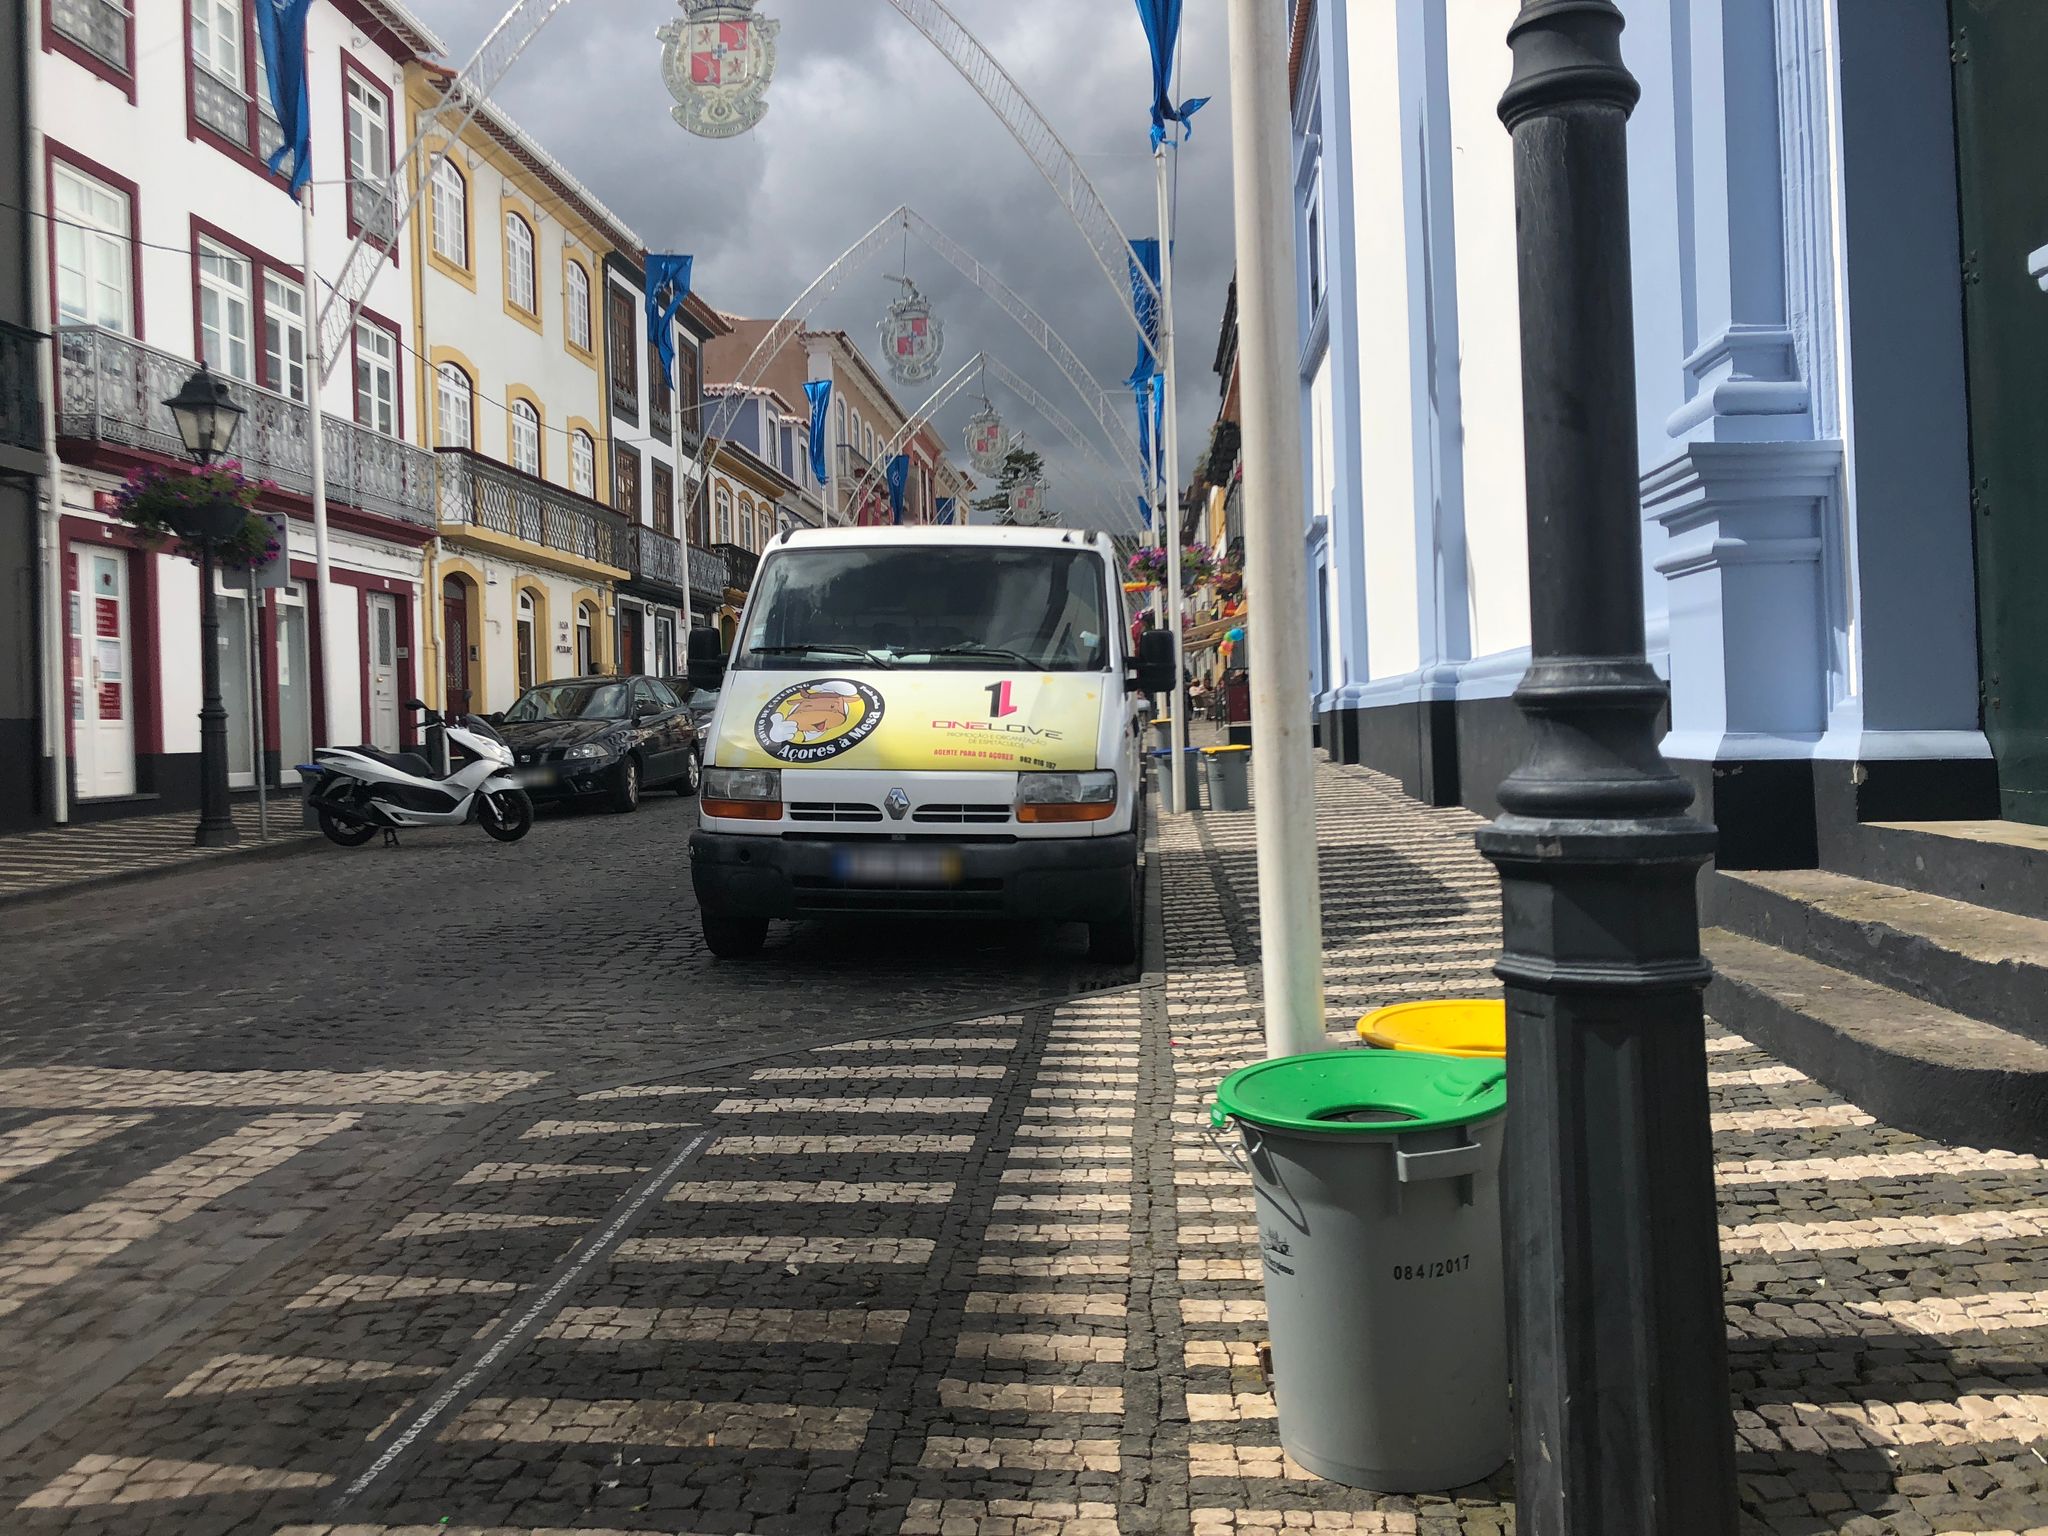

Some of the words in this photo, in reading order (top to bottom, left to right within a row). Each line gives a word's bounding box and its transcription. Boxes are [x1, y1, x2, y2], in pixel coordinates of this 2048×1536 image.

[768, 683, 810, 709] CATERING
[777, 744, 836, 762] Açores
[839, 737, 852, 748] à
[848, 711, 882, 740] Mesa
[946, 731, 989, 740] PROMOÇÃO
[933, 749, 958, 757] AGENTE
[959, 750, 977, 758] PARA
[988, 752, 1014, 761] AÇORES
[1393, 1253, 1470, 1280] 084/2017
